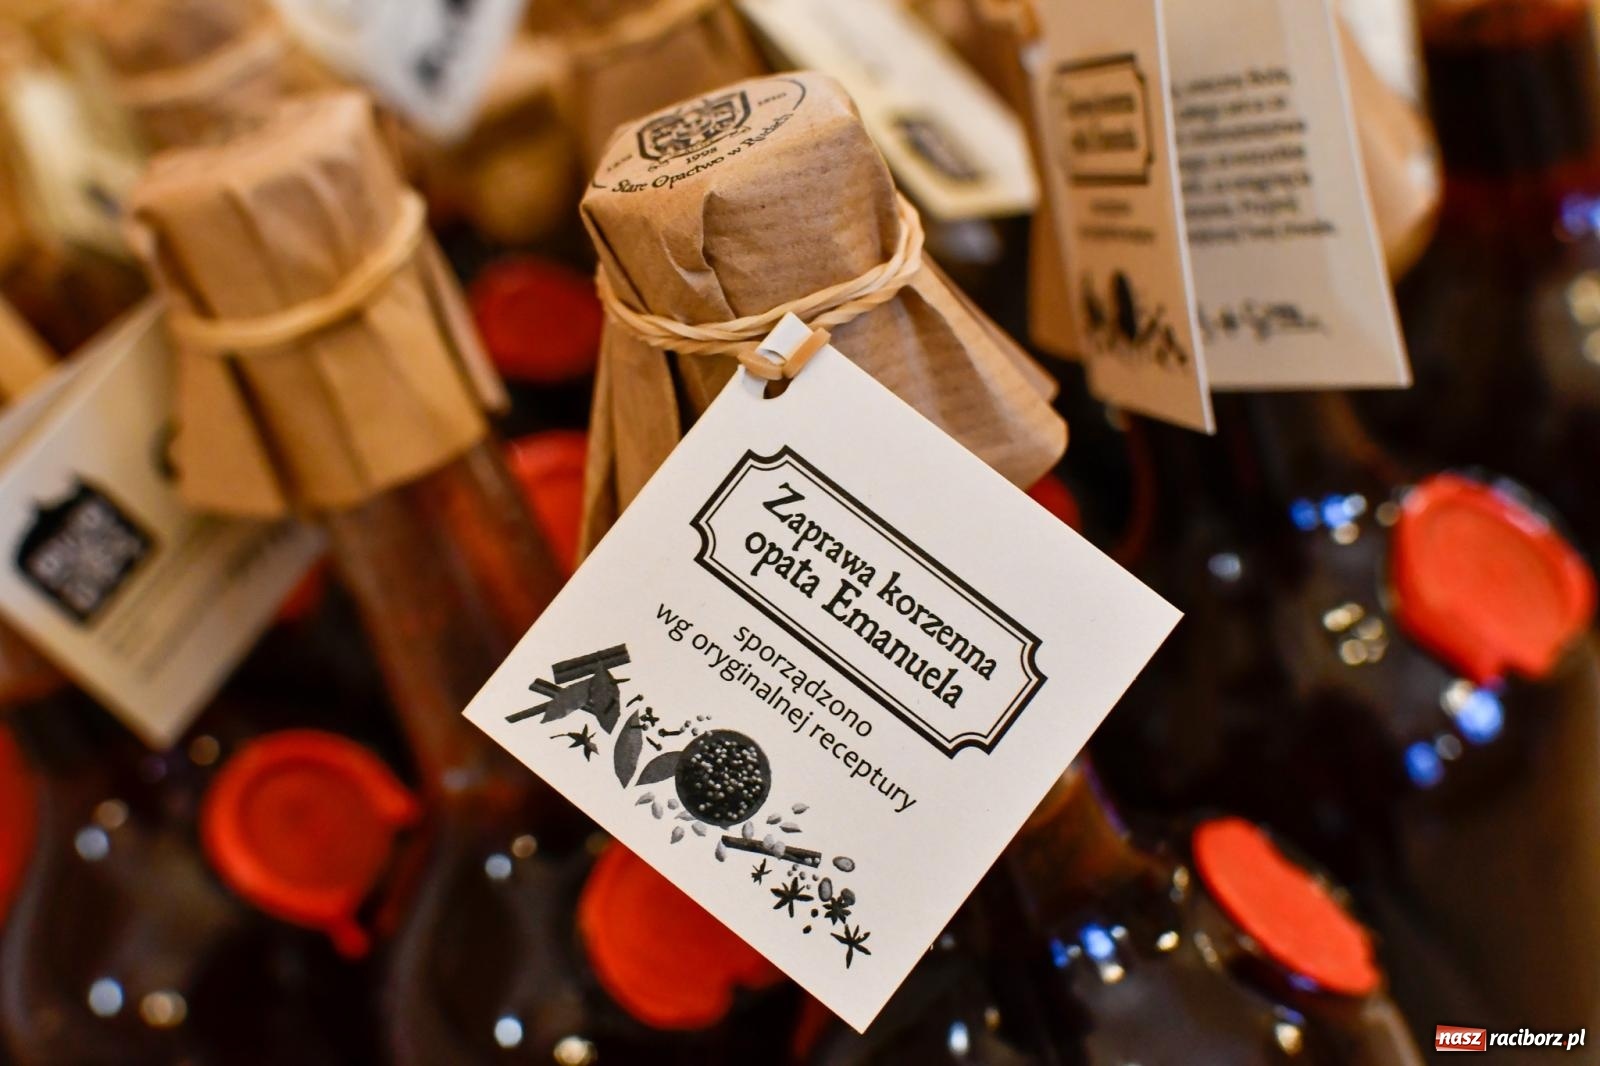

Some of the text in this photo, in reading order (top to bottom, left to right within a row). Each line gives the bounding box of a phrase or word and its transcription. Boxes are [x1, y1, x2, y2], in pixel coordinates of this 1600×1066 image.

[612, 179, 647, 192] Stare
[652, 156, 724, 189] Opactwo
[727, 147, 741, 155] w
[744, 531, 964, 709] opata Emanuela
[762, 482, 997, 680] Zaprawa korzenna
[656, 602, 917, 813] wg oryginalnej receptury
[733, 625, 873, 738] sporządzono
